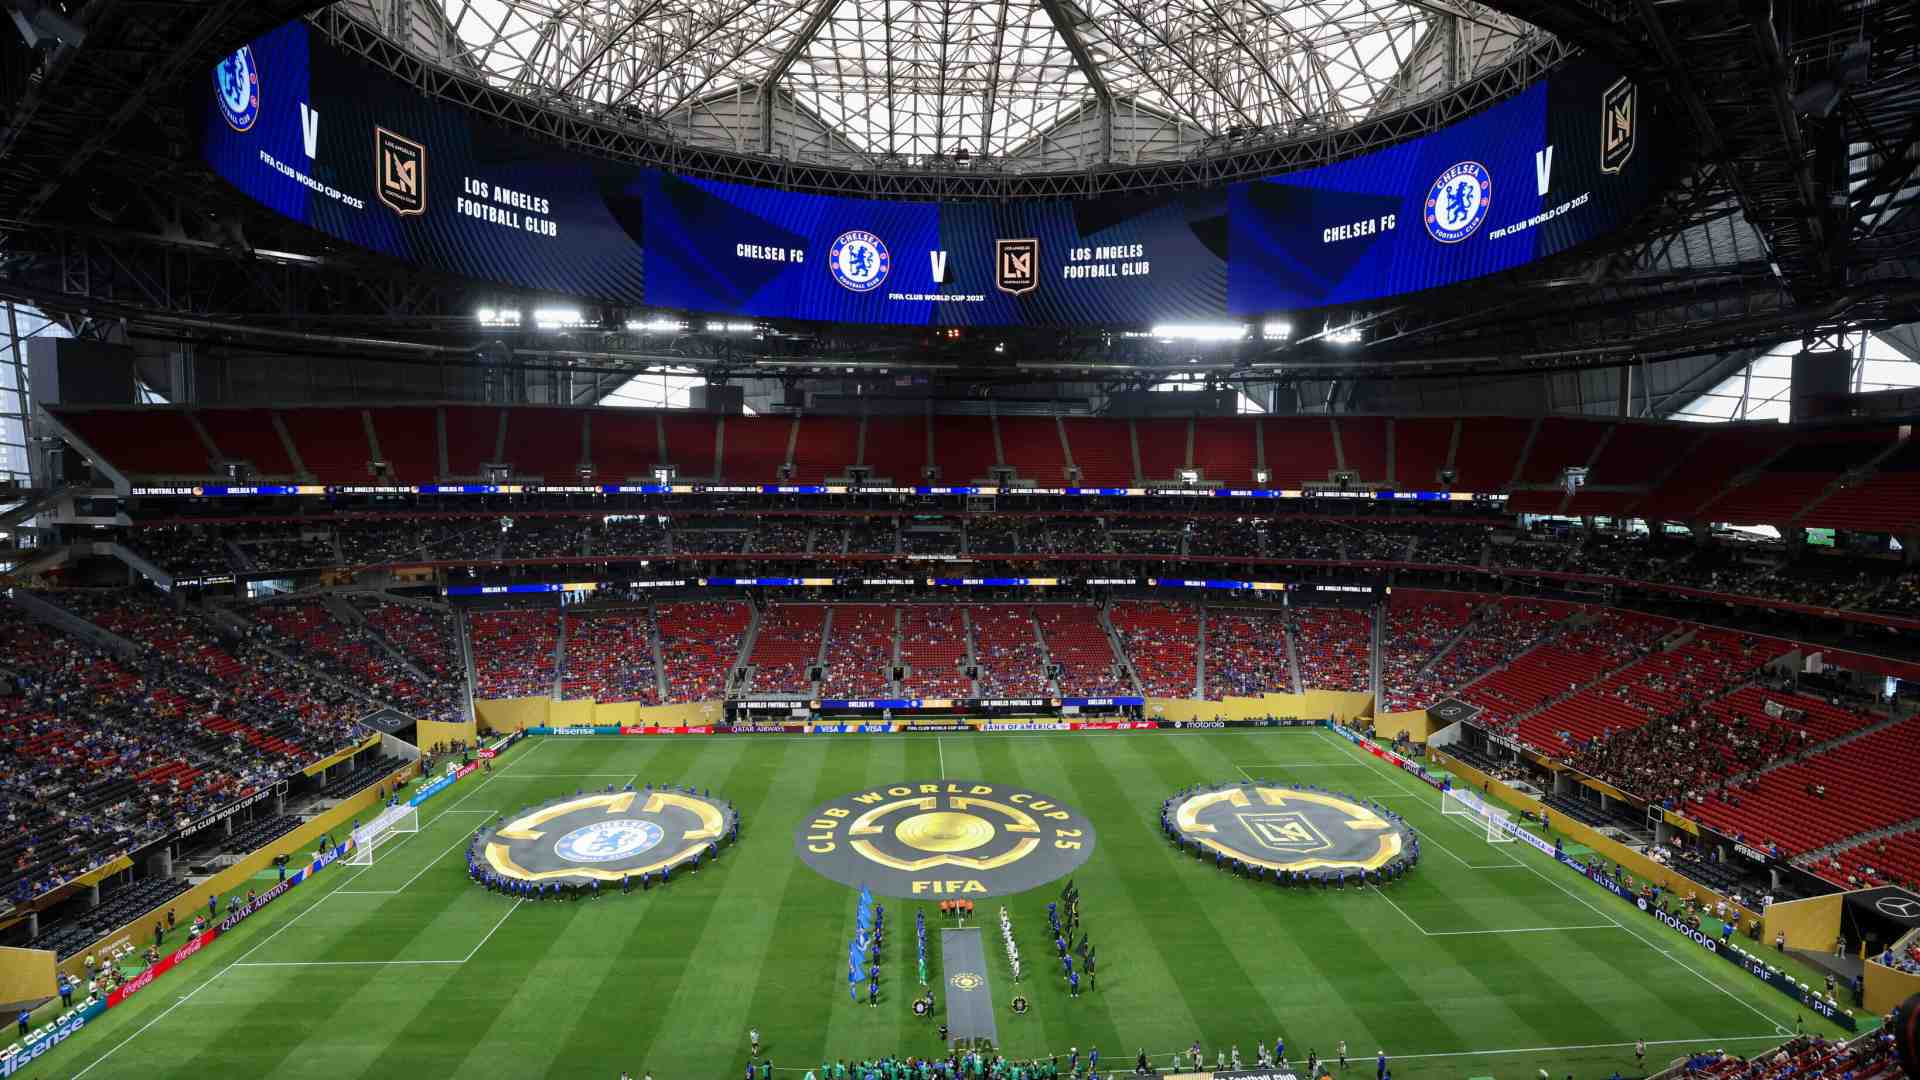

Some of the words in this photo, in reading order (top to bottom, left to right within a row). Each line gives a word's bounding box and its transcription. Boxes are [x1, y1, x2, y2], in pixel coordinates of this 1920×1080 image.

[300, 102, 318, 160] V
[260, 150, 276, 168] FIFA
[276, 160, 294, 178] CLUB
[296, 170, 324, 192] WORLD
[325, 186, 341, 200] CUP
[342, 194, 362, 208] 2025
[1437, 164, 1480, 188] CHELSEA
[1536, 145, 1553, 196] V
[464, 176, 488, 198] LOS
[494, 186, 550, 214] ANGELES
[458, 196, 520, 228] FOOTBALL
[525, 216, 557, 236] CLUB
[1323, 218, 1376, 243] CHELSEA
[1381, 214, 1396, 231] FC
[1490, 228, 1506, 240] FIFA
[1507, 220, 1527, 234] CLUB
[1528, 210, 1555, 226] WORLD
[1556, 202, 1570, 216] CUP
[1572, 192, 1589, 208] 2025
[840, 232, 878, 246] CHELSEA
[736, 243, 786, 262] CHELSEA
[790, 248, 804, 262] FC
[1070, 248, 1092, 262] LOS
[1096, 244, 1144, 260] ANGELES
[930, 250, 946, 282] V
[1064, 264, 1118, 279] FOOTBALL
[1122, 261, 1150, 276] CLUB
[554, 727, 595, 735] Hisense
[1186, 720, 1224, 728] motorola
[181, 826, 197, 838] FIFA
[198, 816, 216, 830] CLUB
[216, 804, 240, 820] WORLD
[240, 798, 253, 808] CUP
[807, 807, 850, 854] CLUB
[853, 784, 993, 804] WORLD
[1009, 794, 1070, 821] CUP
[1054, 828, 1082, 850] 25
[320, 848, 338, 867] VISA
[912, 880, 988, 894] FIFA
[1594, 873, 1620, 896] ULTRA
[221, 906, 252, 930] QATAR
[254, 880, 289, 910] AIRWAYS
[1655, 908, 1717, 953] motorola
[1752, 964, 1773, 981] PIF
[1814, 1001, 1834, 1018] PIF
